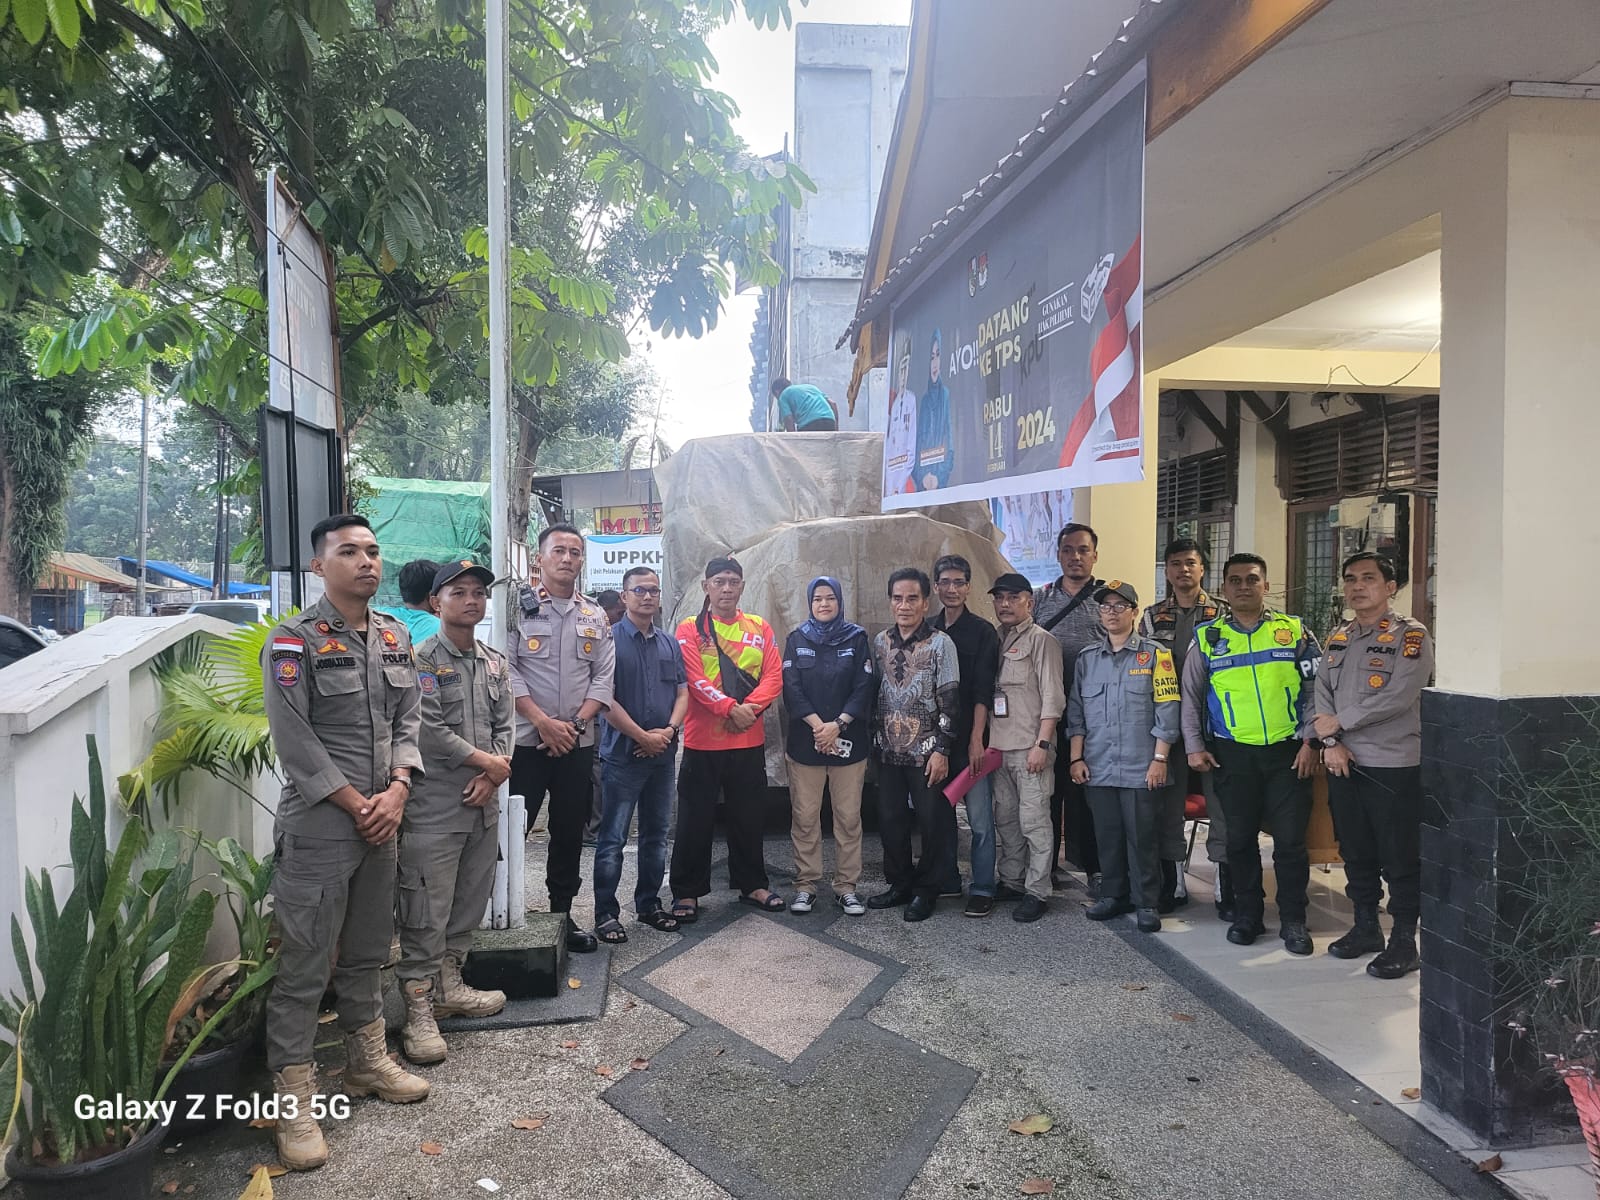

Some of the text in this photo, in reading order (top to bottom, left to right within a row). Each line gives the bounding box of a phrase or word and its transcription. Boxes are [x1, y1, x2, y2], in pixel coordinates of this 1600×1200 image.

[978, 295, 1029, 348] DATANG
[1042, 293, 1068, 316] GUNAKAN
[979, 334, 1021, 377] KE TPS
[983, 393, 1012, 425] RABU
[1017, 406, 1055, 450] 2024
[988, 421, 1003, 460] 14
[1366, 646, 1396, 655] POLRI
